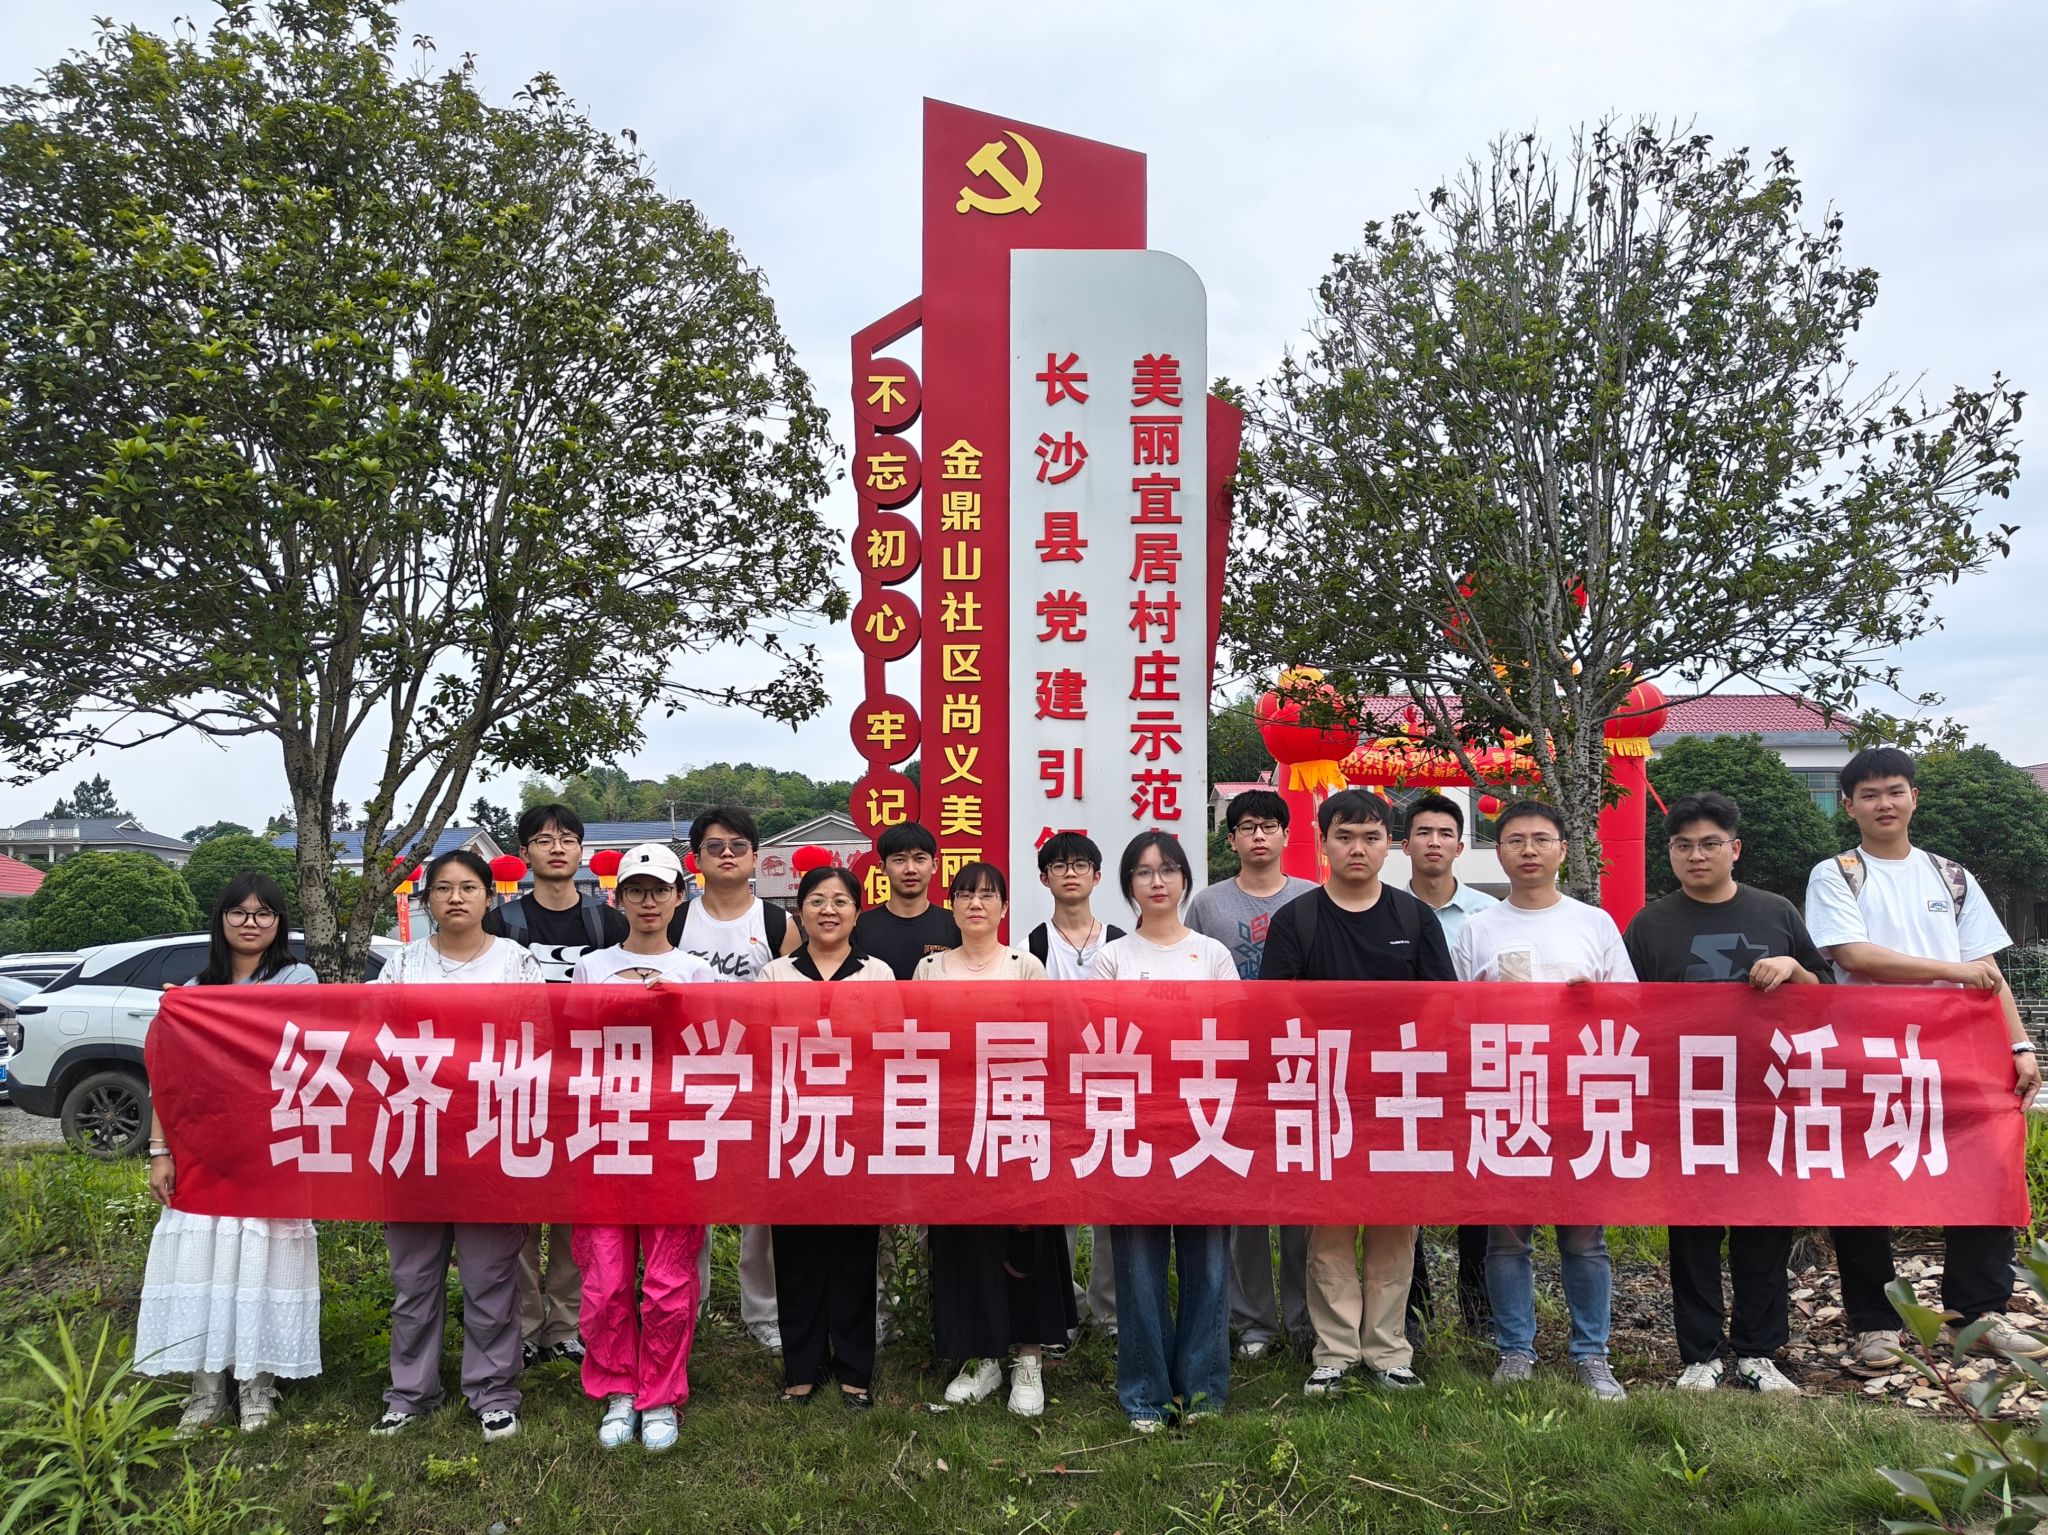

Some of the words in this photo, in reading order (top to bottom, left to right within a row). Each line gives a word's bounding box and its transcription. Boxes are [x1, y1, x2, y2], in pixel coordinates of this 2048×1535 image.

[1035, 352, 1088, 856] 长沙县党建引
[268, 1018, 1949, 1181] 经济地理学院直属党支部主题党日活动
